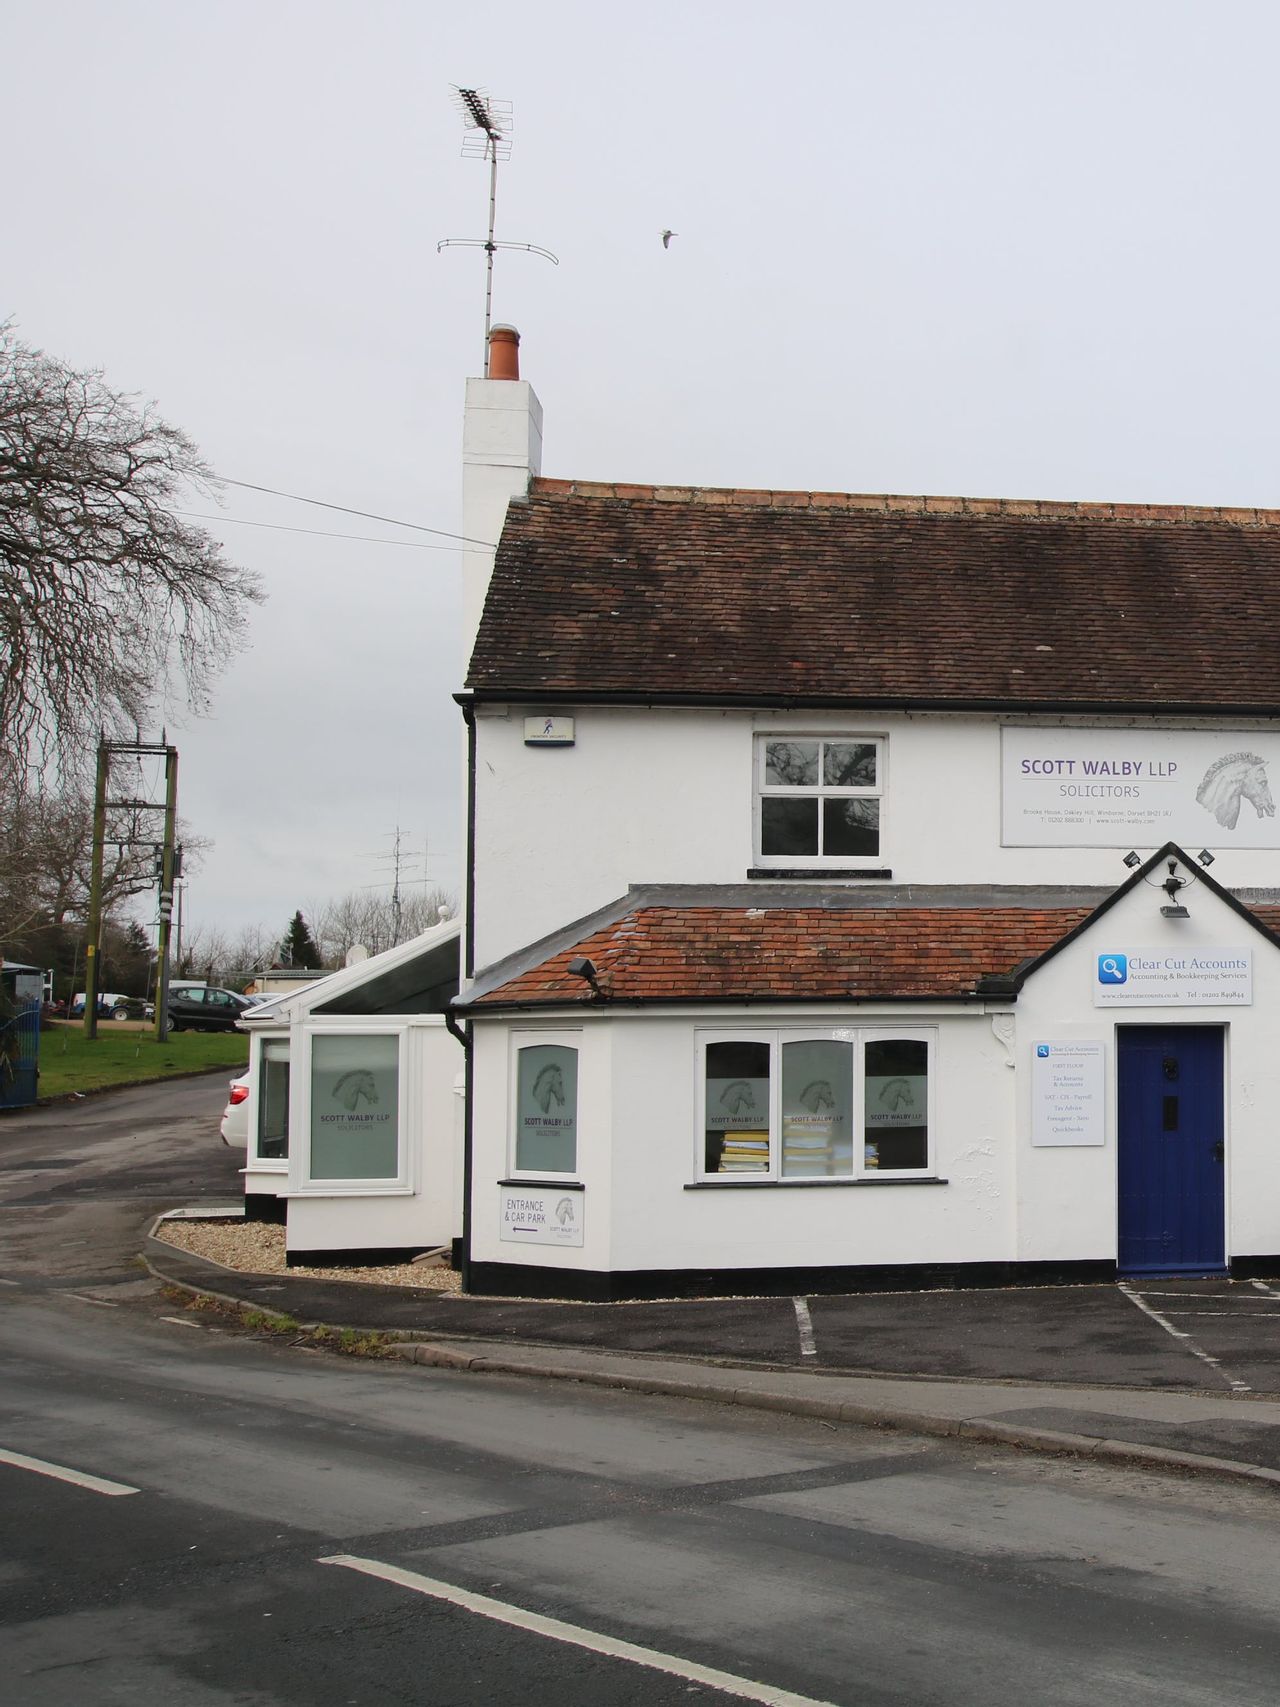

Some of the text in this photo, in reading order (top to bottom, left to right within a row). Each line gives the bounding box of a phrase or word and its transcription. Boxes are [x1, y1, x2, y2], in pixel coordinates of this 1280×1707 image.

[1021, 760, 1178, 777] SCOTT WALBY LLP
[1059, 785, 1140, 798] SOLICITORS
[1128, 957, 1247, 970] Clear Cut Accounts
[1129, 973, 1168, 981] Accounting
[1176, 973, 1220, 981] Bookkeeping
[376, 1113, 390, 1121] LLP
[524, 1117, 573, 1126] SCOTT WALBY LLP
[507, 1199, 544, 1212] ENTRANCE
[504, 1211, 546, 1224] & CAR PARK
